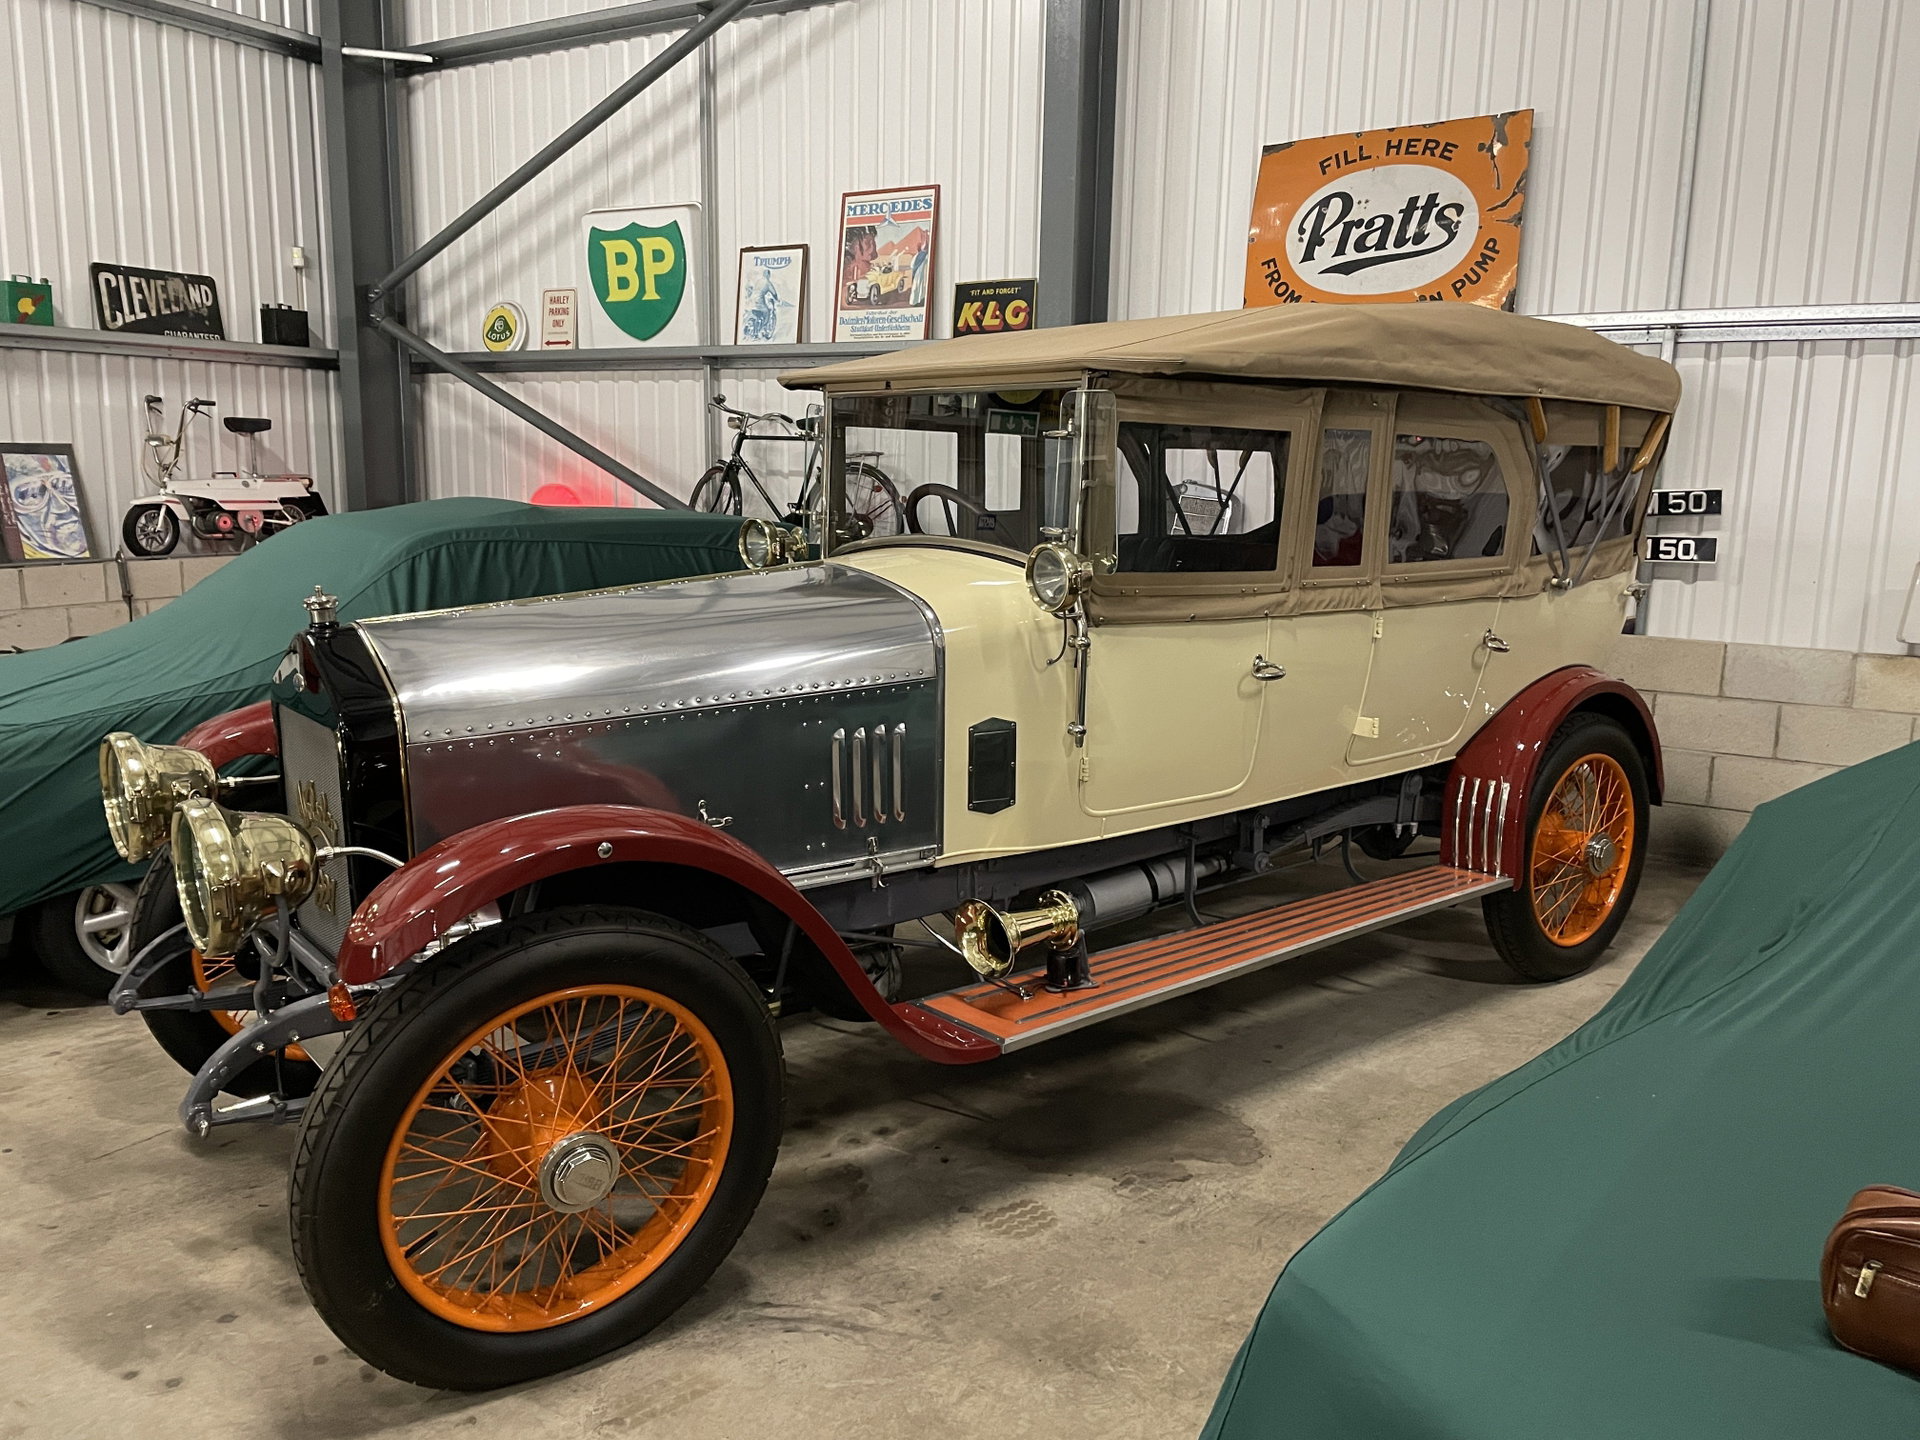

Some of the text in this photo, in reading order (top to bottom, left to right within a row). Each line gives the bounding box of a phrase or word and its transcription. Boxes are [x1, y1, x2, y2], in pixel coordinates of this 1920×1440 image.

[1319, 138, 1459, 175] FILL HERE
[847, 198, 933, 216] MERCEDES
[1298, 191, 1465, 276] Pratts
[600, 236, 675, 302] BP
[754, 256, 792, 269] TRIUMPH
[1451, 237, 1501, 298] PUMP
[1261, 257, 1303, 303] FROM
[98, 271, 213, 330] CLEVELAND
[548, 307, 570, 316] PARKING
[549, 295, 570, 305] HARLEY
[488, 330, 511, 341] LOTUS
[552, 319, 565, 328] ONLY
